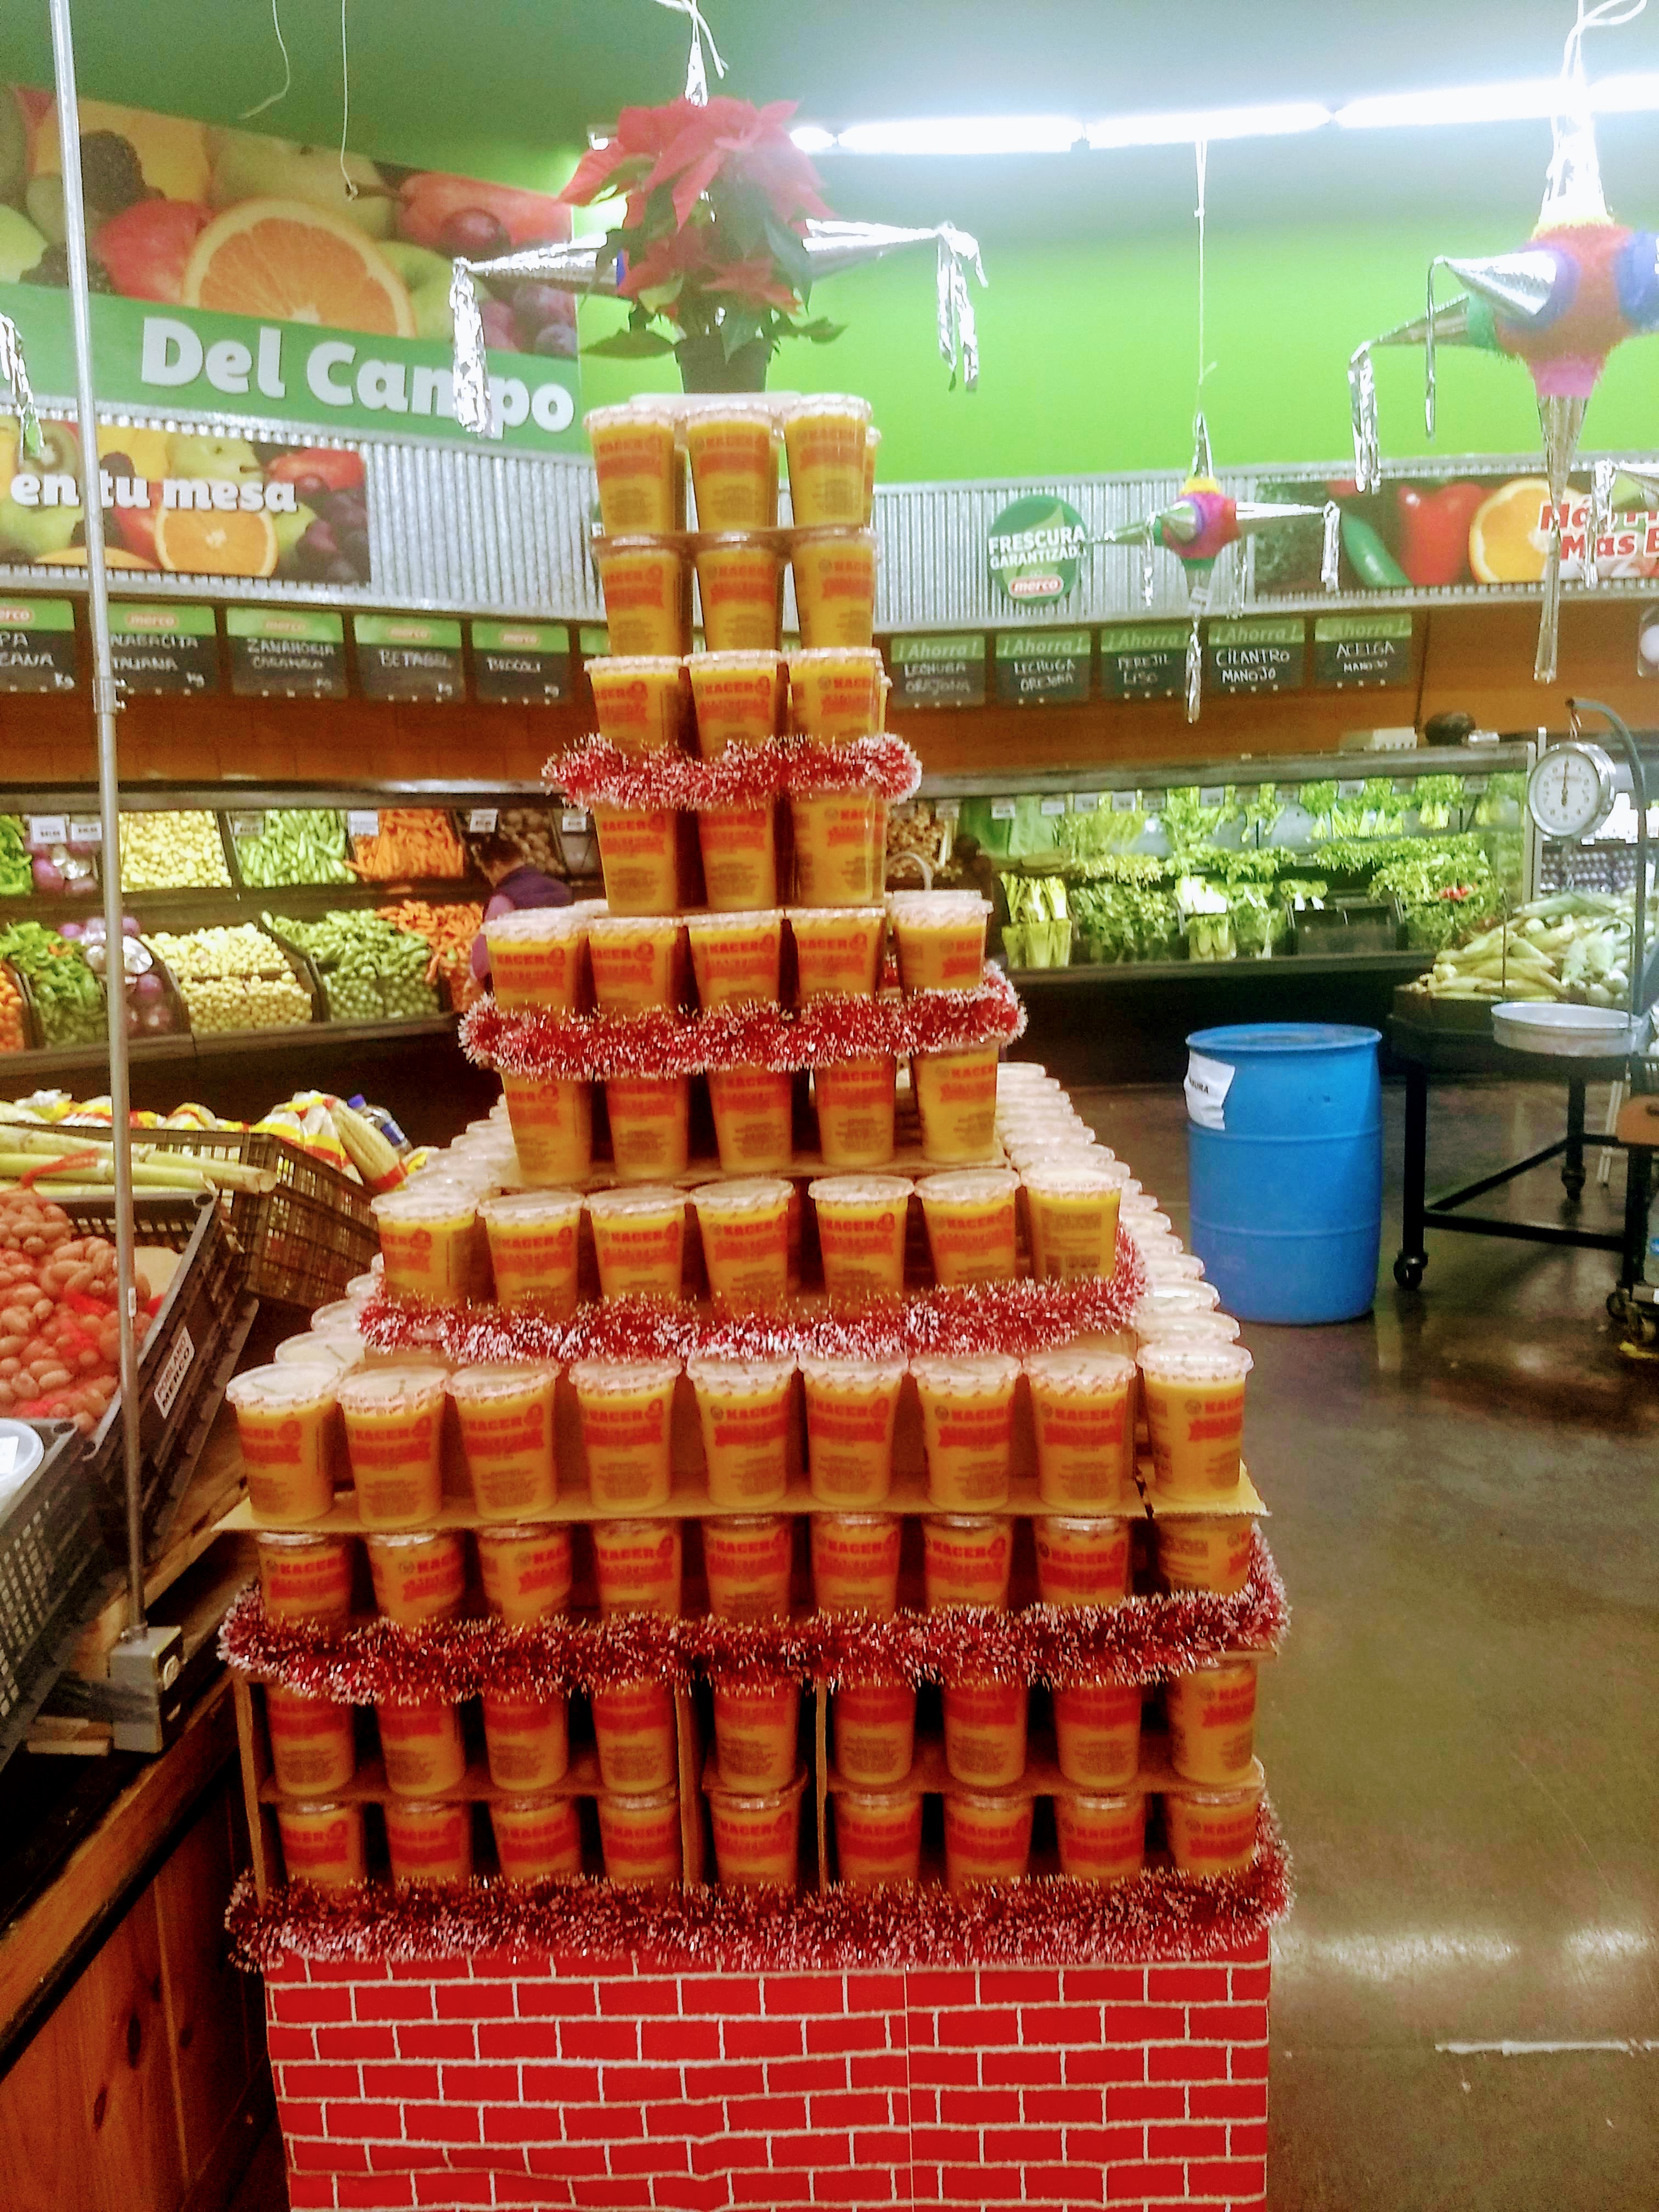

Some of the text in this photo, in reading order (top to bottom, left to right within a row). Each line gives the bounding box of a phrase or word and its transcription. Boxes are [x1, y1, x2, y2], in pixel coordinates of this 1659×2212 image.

[141, 317, 574, 439] Del Campo
[10, 469, 298, 512] en tu mesa
[988, 524, 1085, 555] FRESCURA
[1014, 579, 1058, 592] merco
[130, 615, 176, 627] merco
[1013, 658, 1076, 676] LECHUGA
[1216, 647, 1288, 668] CILANTRO
[1222, 665, 1277, 684] MANOJO
